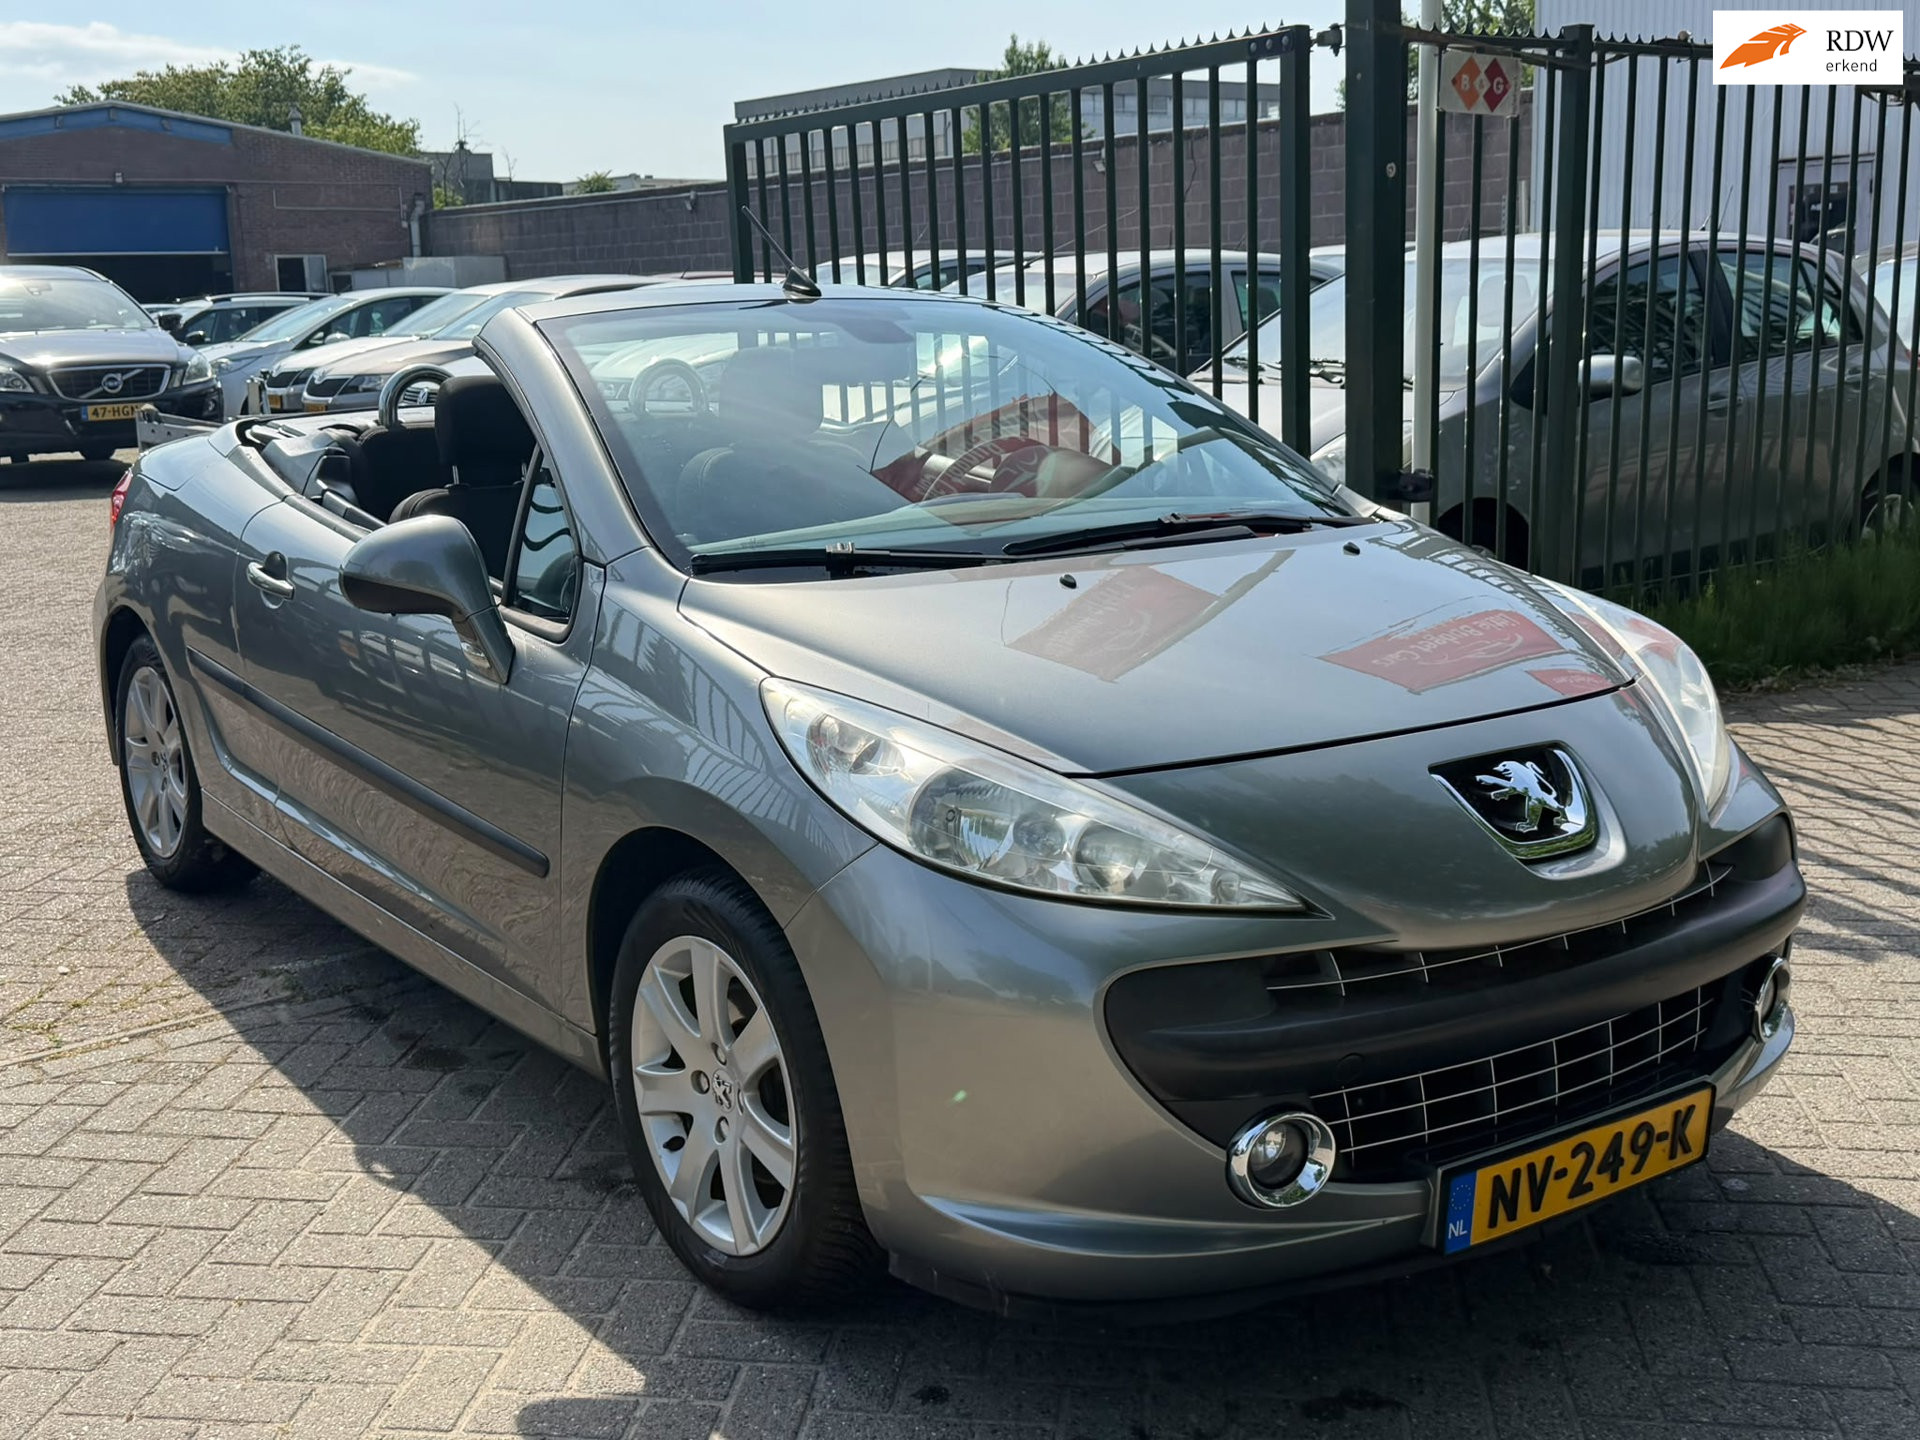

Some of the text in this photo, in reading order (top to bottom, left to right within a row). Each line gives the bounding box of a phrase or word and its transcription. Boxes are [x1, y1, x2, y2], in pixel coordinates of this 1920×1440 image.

[1419, 624, 1484, 653] Budget
[1371, 649, 1421, 668] Cars
[1488, 1104, 1697, 1230] NV-249-K
[1447, 1219, 1468, 1241] NL
